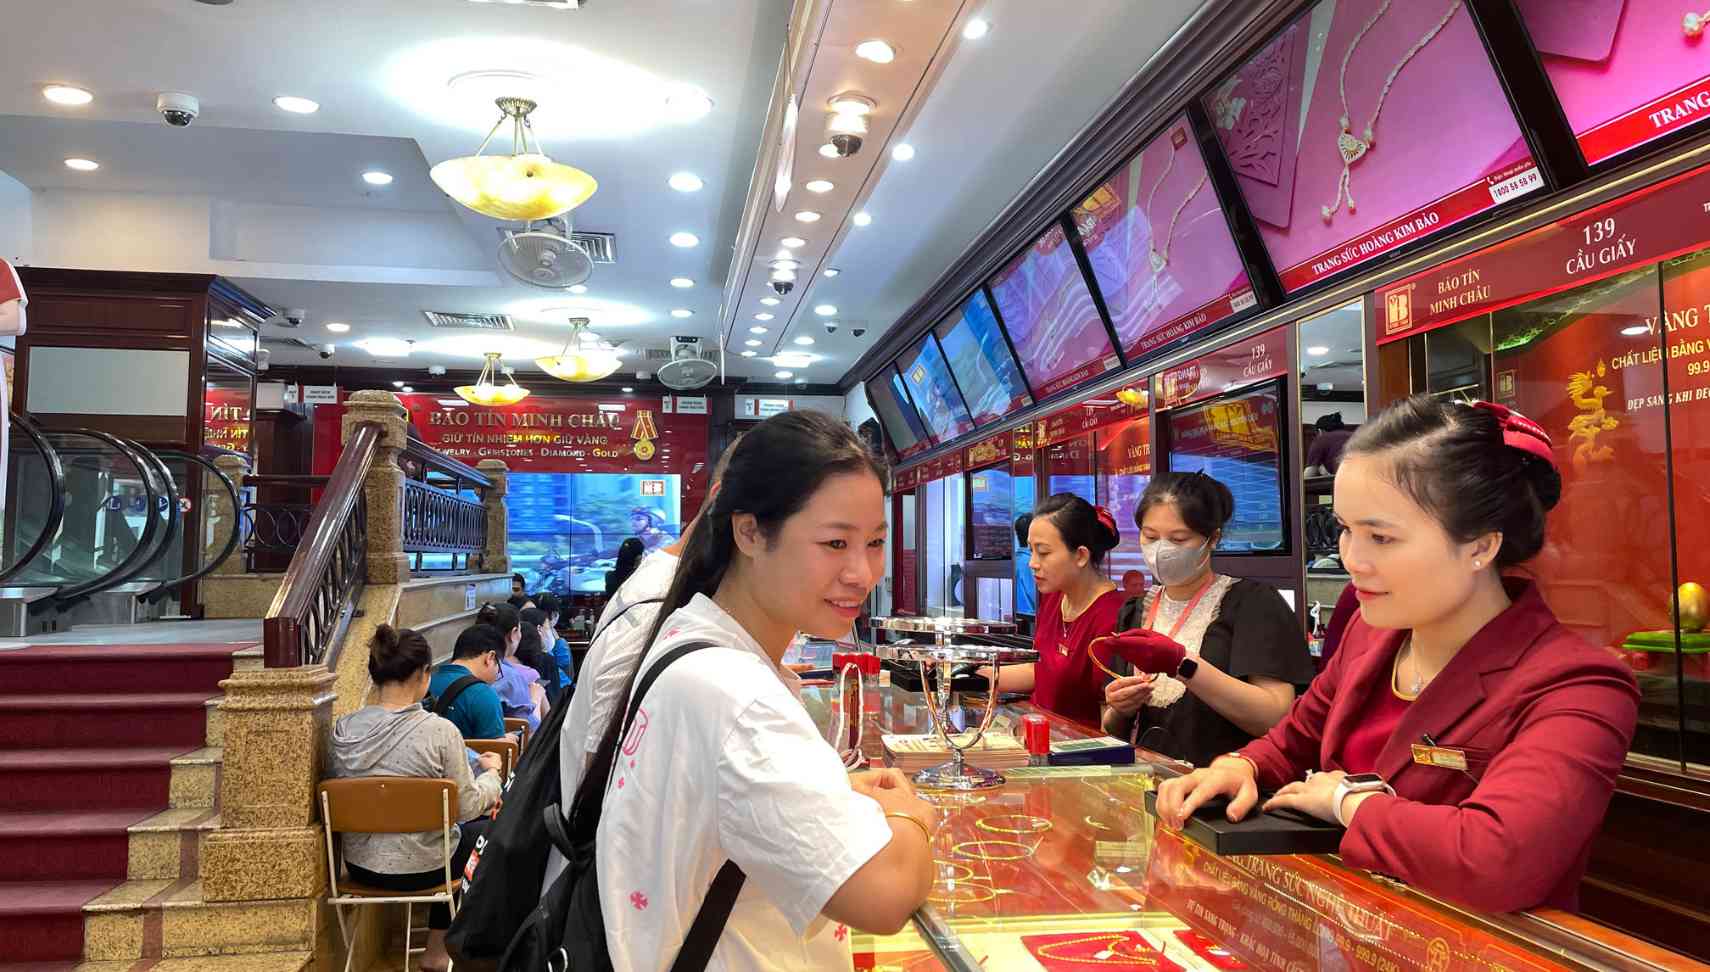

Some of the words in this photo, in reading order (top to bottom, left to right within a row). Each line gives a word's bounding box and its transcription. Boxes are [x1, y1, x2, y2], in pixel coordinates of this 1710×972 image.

[1648, 91, 1710, 128] TRANG
[1583, 217, 1615, 245] 139
[1312, 255, 1342, 275] TRANG
[1341, 246, 1360, 263] SỨC
[1359, 231, 1394, 255] HOÀNG
[1393, 223, 1416, 240] KIM
[1415, 212, 1440, 231] BẢO
[1566, 248, 1595, 275] CẦU
[1599, 233, 1636, 264] GIẤY
[1463, 269, 1480, 286] TÍN
[1429, 296, 1458, 315] MINH
[1459, 285, 1490, 306] CHÂU
[1251, 344, 1265, 359] 139
[1611, 349, 1640, 370] CHẤT
[1675, 390, 1693, 404] KHI
[429, 409, 469, 426] BẢO
[473, 408, 507, 425] TÍN
[510, 411, 562, 427] MINH
[465, 431, 484, 443] TÍN
[576, 433, 608, 445] VÀNG
[592, 447, 618, 458] GOLD
